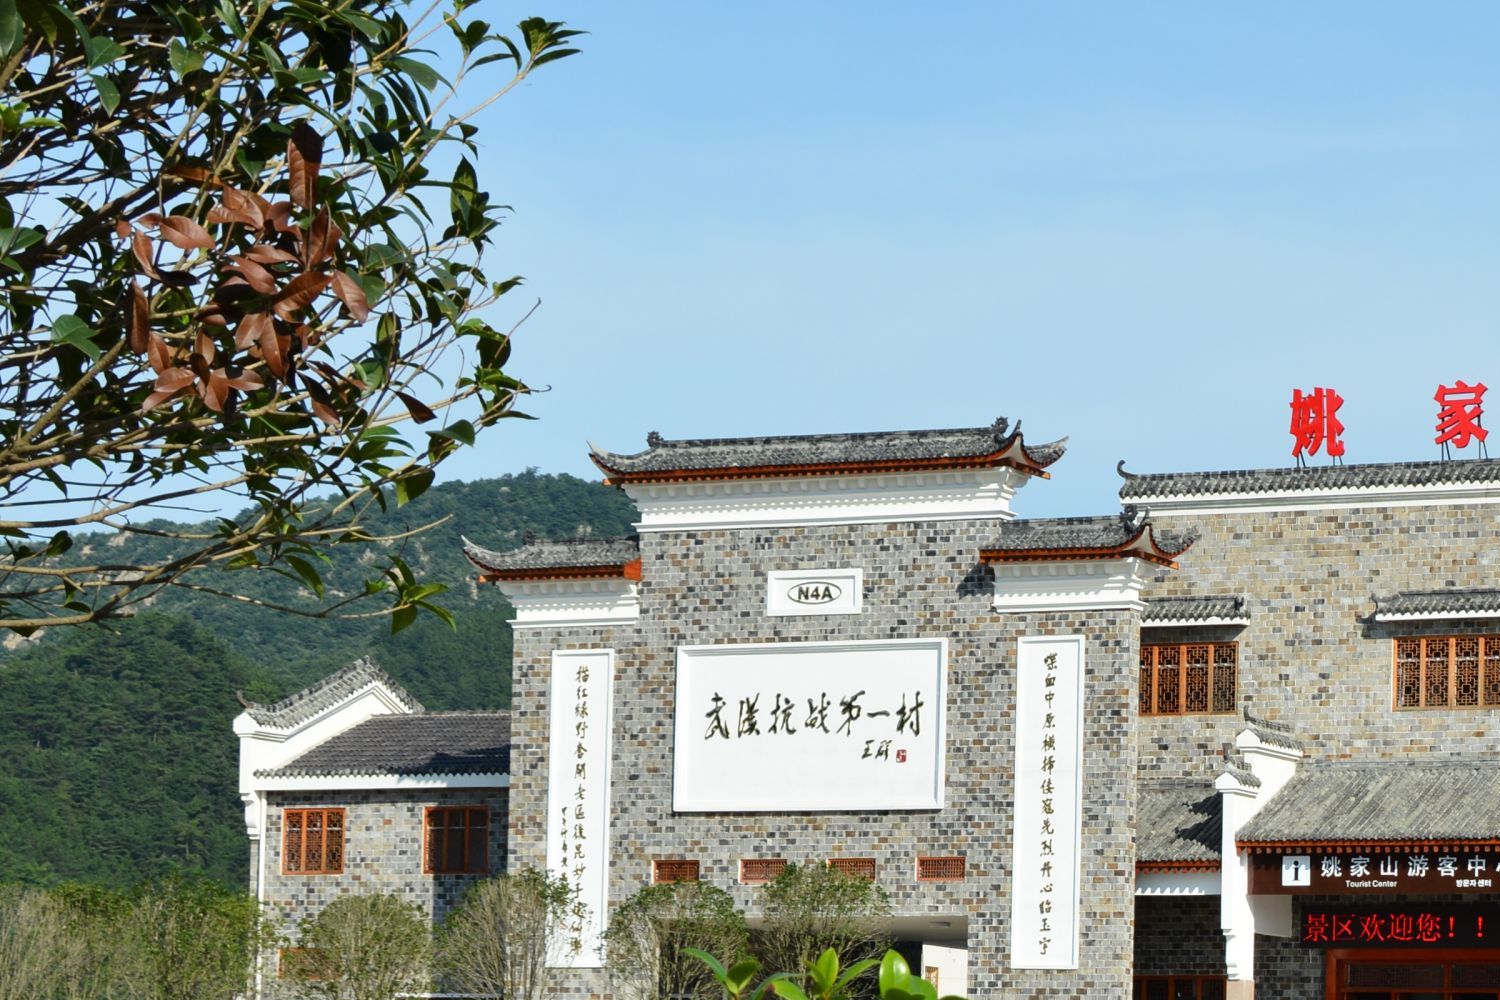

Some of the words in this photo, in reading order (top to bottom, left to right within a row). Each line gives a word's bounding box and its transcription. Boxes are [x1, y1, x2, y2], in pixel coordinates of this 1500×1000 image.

[797, 586, 833, 601] N4A
[1345, 880, 1371, 888] Tourist
[1372, 880, 1398, 888] Center
